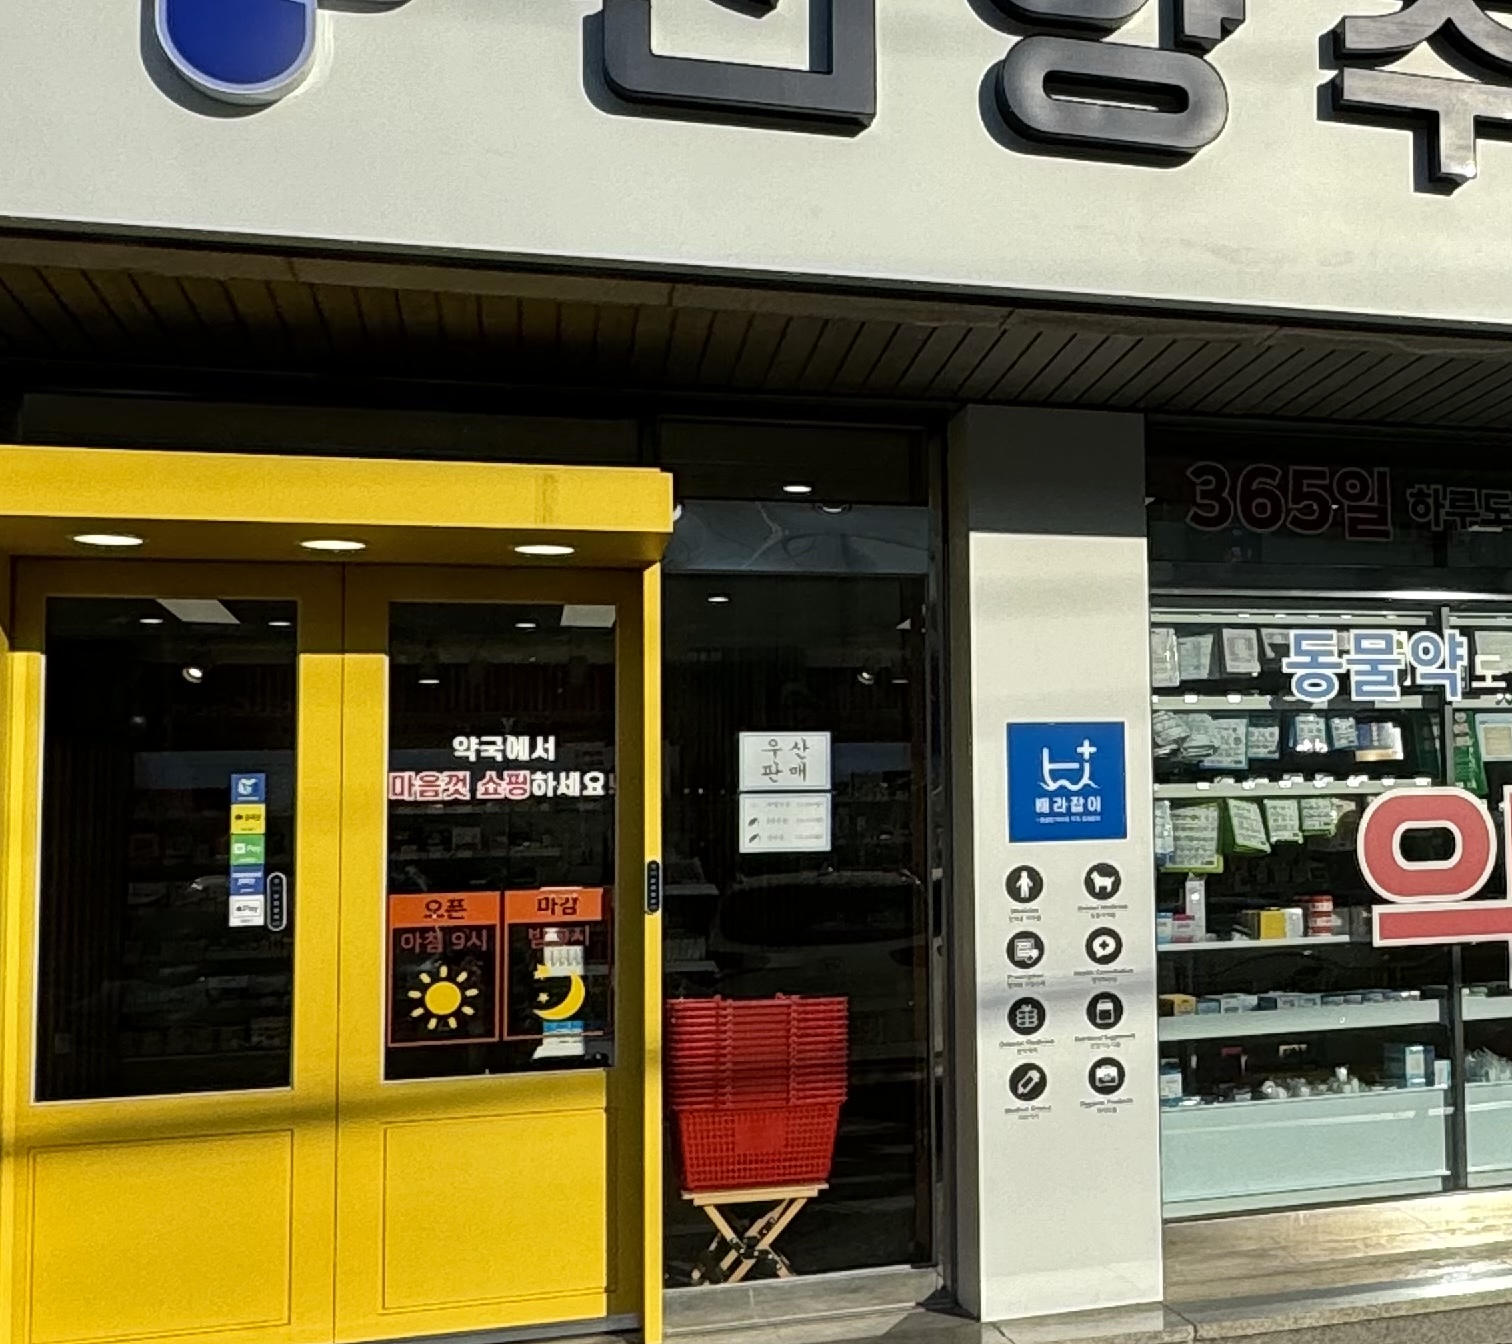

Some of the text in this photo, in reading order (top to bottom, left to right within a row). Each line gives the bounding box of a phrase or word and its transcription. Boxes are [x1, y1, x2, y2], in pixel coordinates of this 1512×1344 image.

[1184, 460, 1394, 542] 365일
[452, 735, 557, 762] 약국에서
[388, 771, 471, 801] 마음껏
[423, 895, 580, 920] 오픈 마감
[400, 928, 488, 954] 아침 9시
